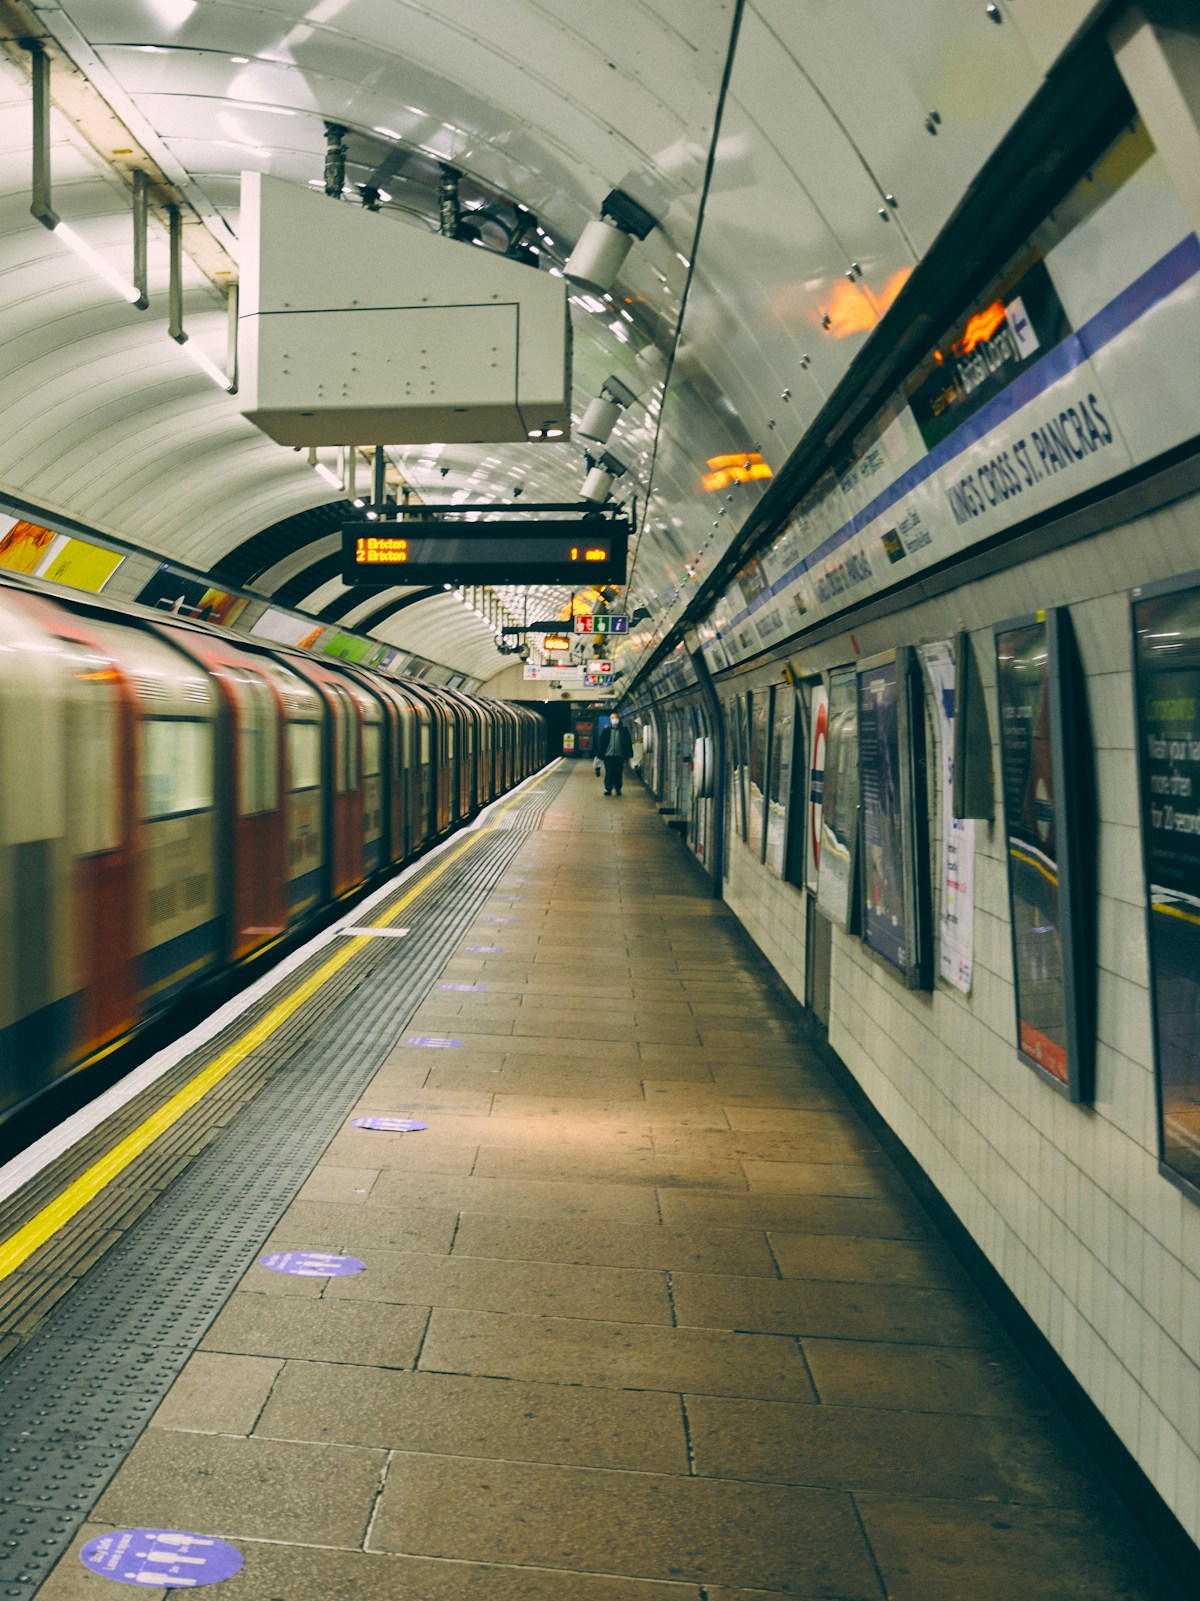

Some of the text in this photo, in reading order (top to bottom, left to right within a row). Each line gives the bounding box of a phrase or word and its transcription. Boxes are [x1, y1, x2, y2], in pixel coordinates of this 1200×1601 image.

[977, 451, 1023, 508] CROSS
[1013, 439, 1044, 487] ST.
[1031, 393, 1113, 477] PANCRAS
[356, 537, 407, 549] 1 Brixton
[355, 547, 605, 561] 2 Brixton 1 min
